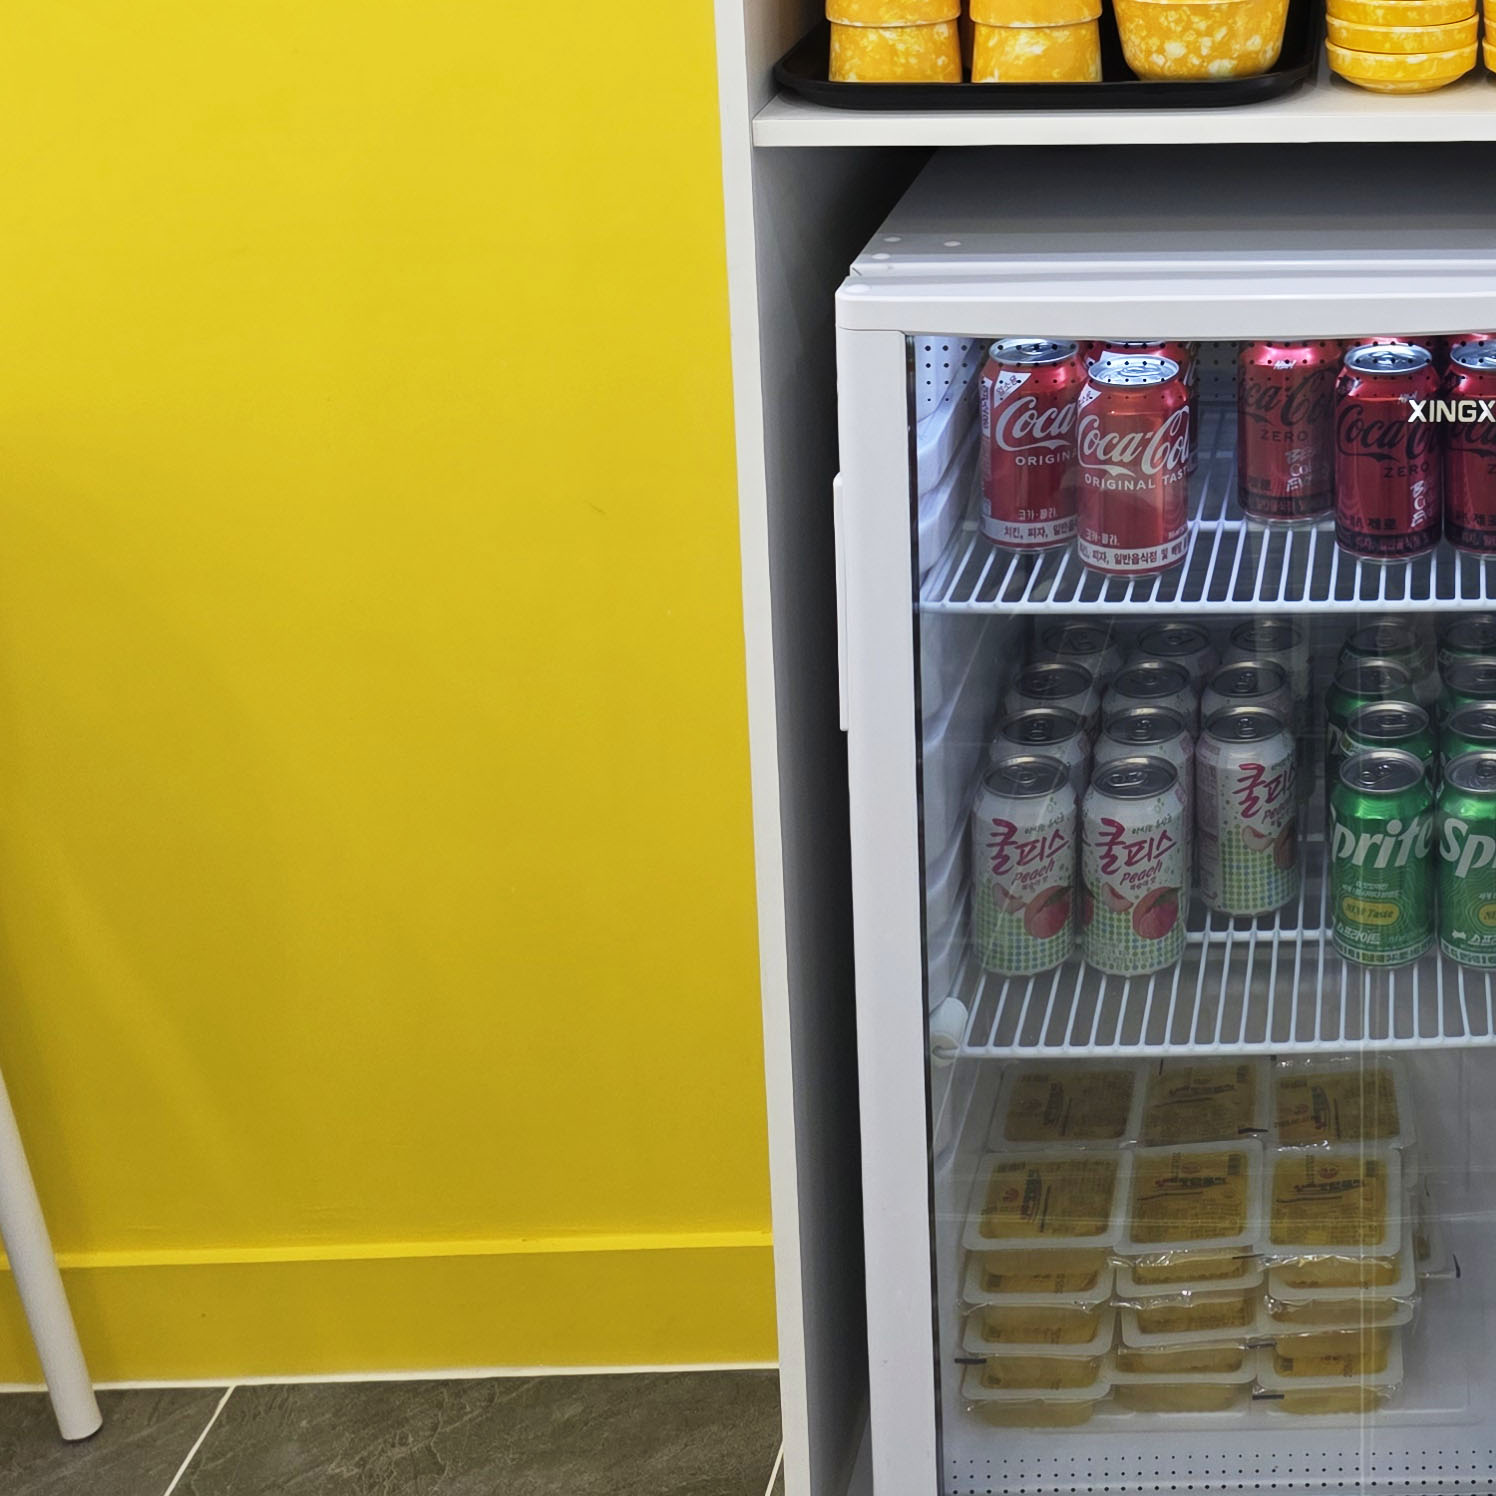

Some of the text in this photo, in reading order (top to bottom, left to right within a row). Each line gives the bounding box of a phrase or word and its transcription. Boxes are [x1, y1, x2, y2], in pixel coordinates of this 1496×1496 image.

[1407, 399, 1496, 423] XINGX
[1078, 405, 1189, 476] Coca-Col
[1260, 429, 1309, 443] ZERO
[1015, 449, 1077, 466] ORIGIN
[1084, 466, 1188, 491] ORIGINAL TAST
[1384, 462, 1429, 479] ZERO
[1113, 550, 1158, 566] 일반음식점
[985, 817, 1070, 876] 쿨피스
[1094, 817, 1178, 876] 쿨피스
[1331, 804, 1433, 869] prite
